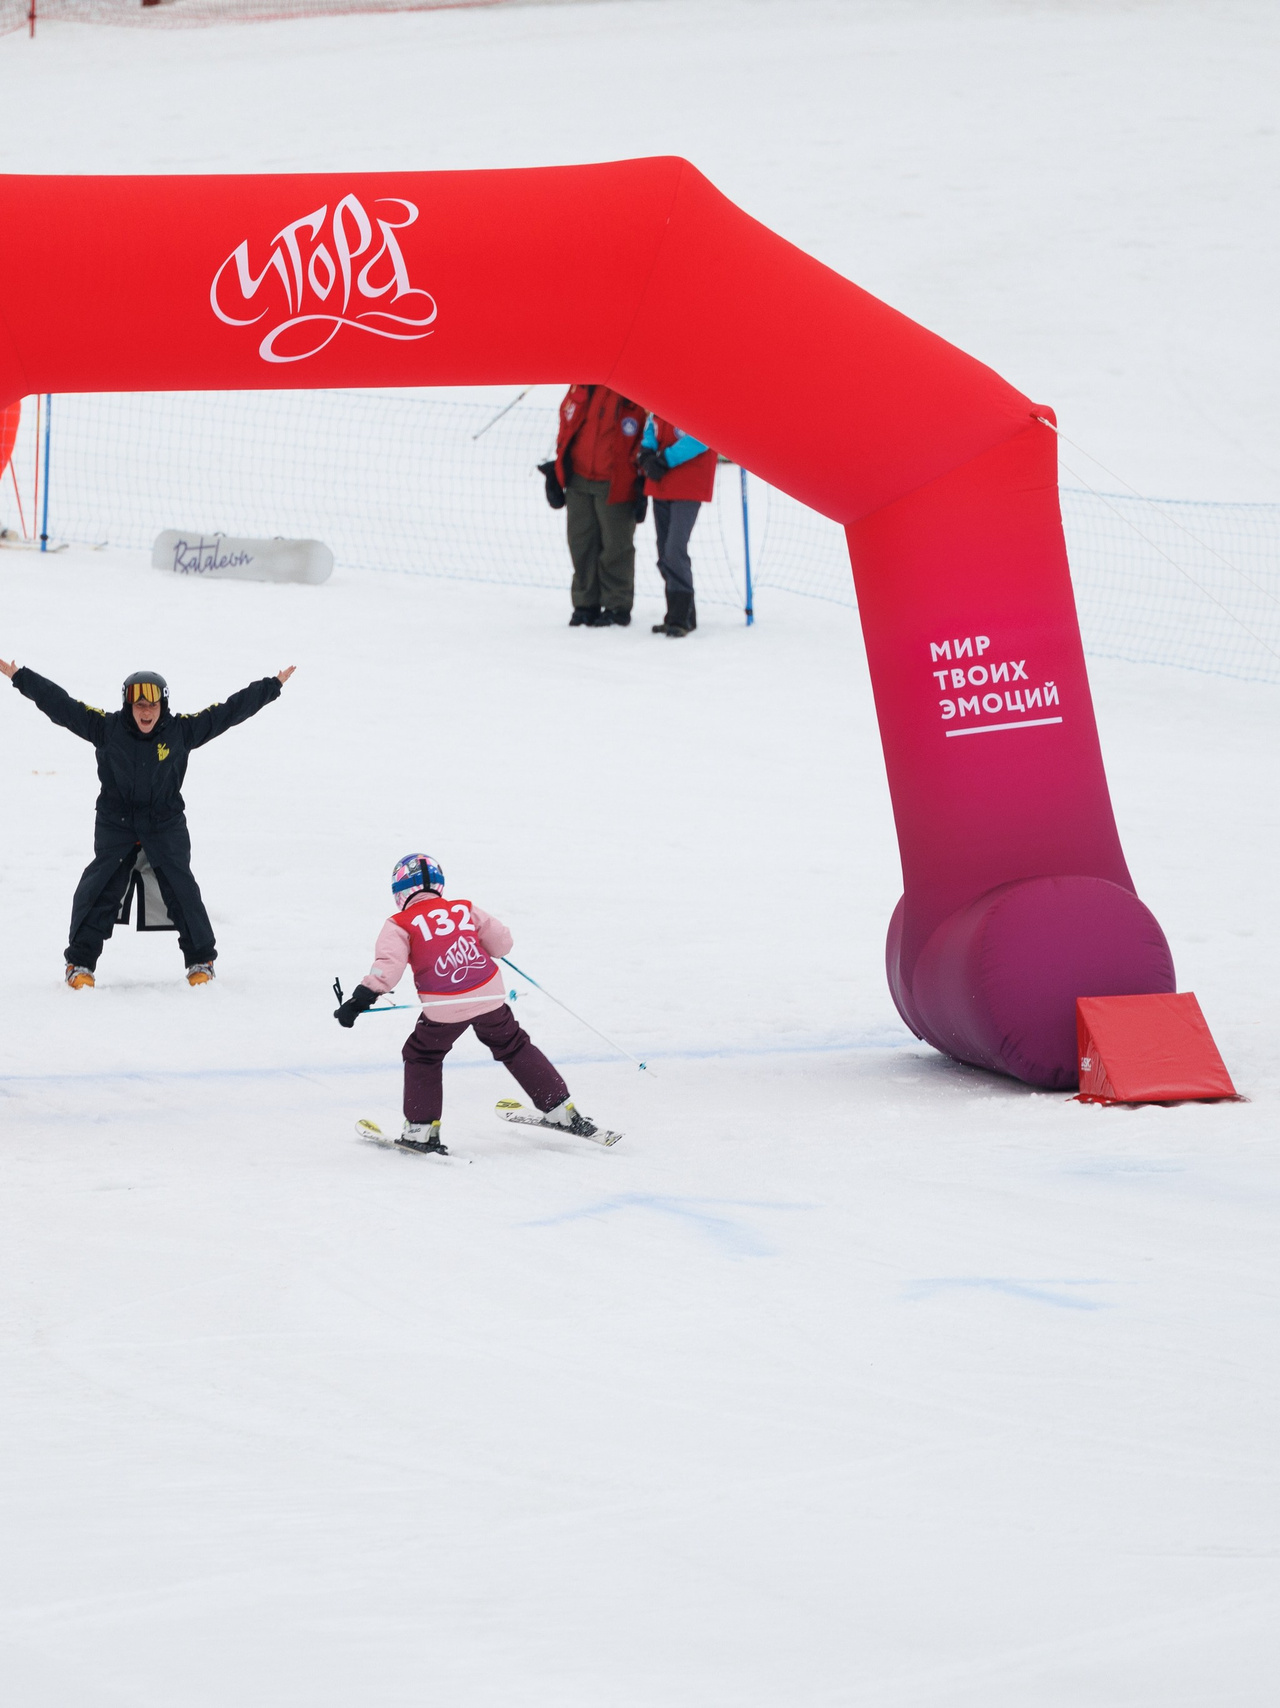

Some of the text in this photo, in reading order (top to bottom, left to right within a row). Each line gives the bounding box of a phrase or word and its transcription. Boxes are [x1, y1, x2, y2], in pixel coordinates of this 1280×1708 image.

[172, 536, 254, 575] Bataleon
[929, 635, 991, 663] МИР
[933, 660, 1029, 691] ТВОИХ
[939, 681, 1060, 720] ЭМОЦИЙ
[410, 904, 476, 942] 132
